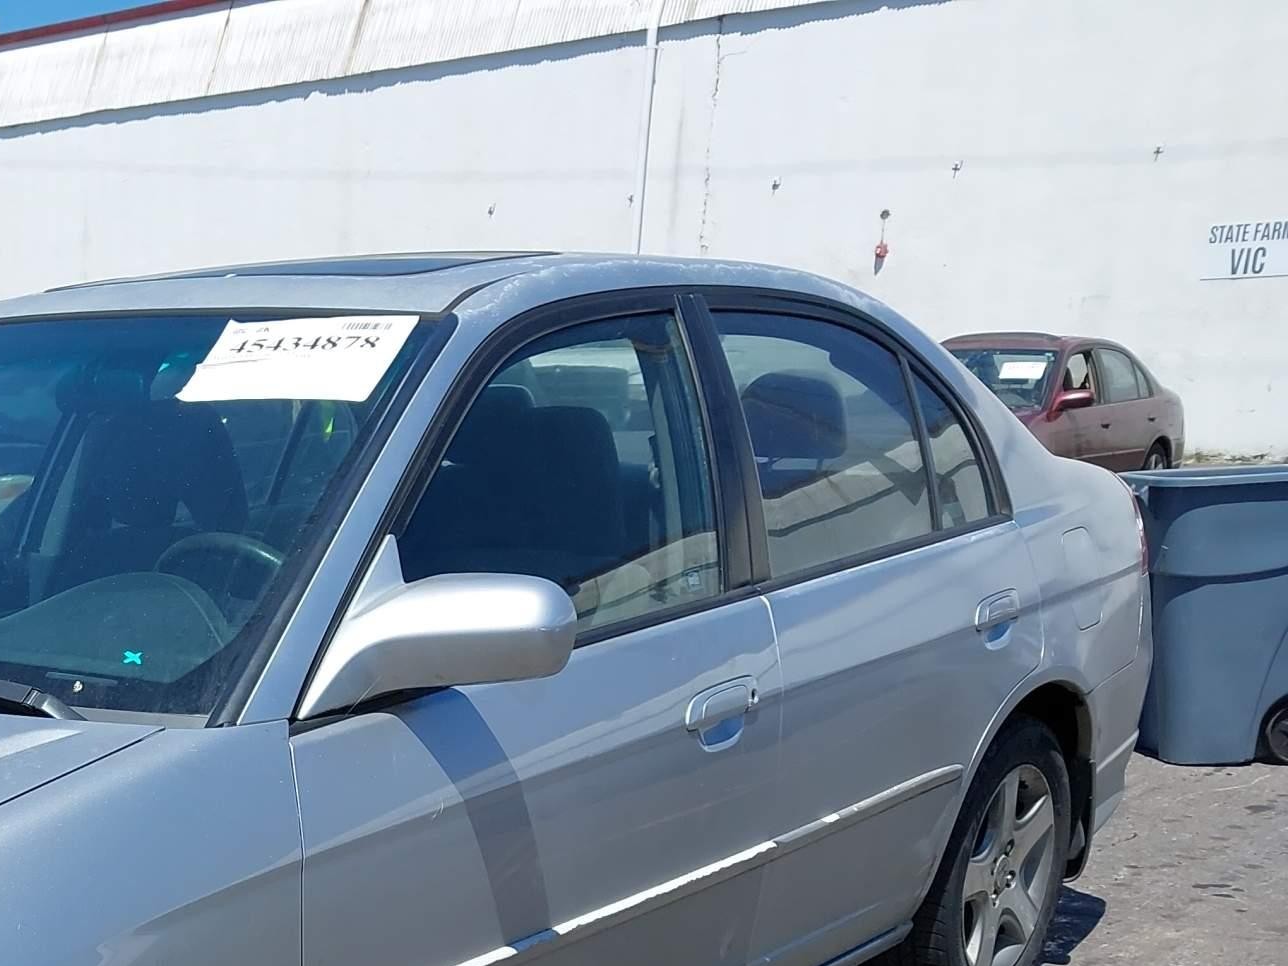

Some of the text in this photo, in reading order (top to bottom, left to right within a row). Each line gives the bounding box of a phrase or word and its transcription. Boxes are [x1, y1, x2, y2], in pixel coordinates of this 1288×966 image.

[1208, 223, 1250, 244] STATE
[1230, 246, 1267, 275] VIC
[230, 335, 381, 353] 45434878
